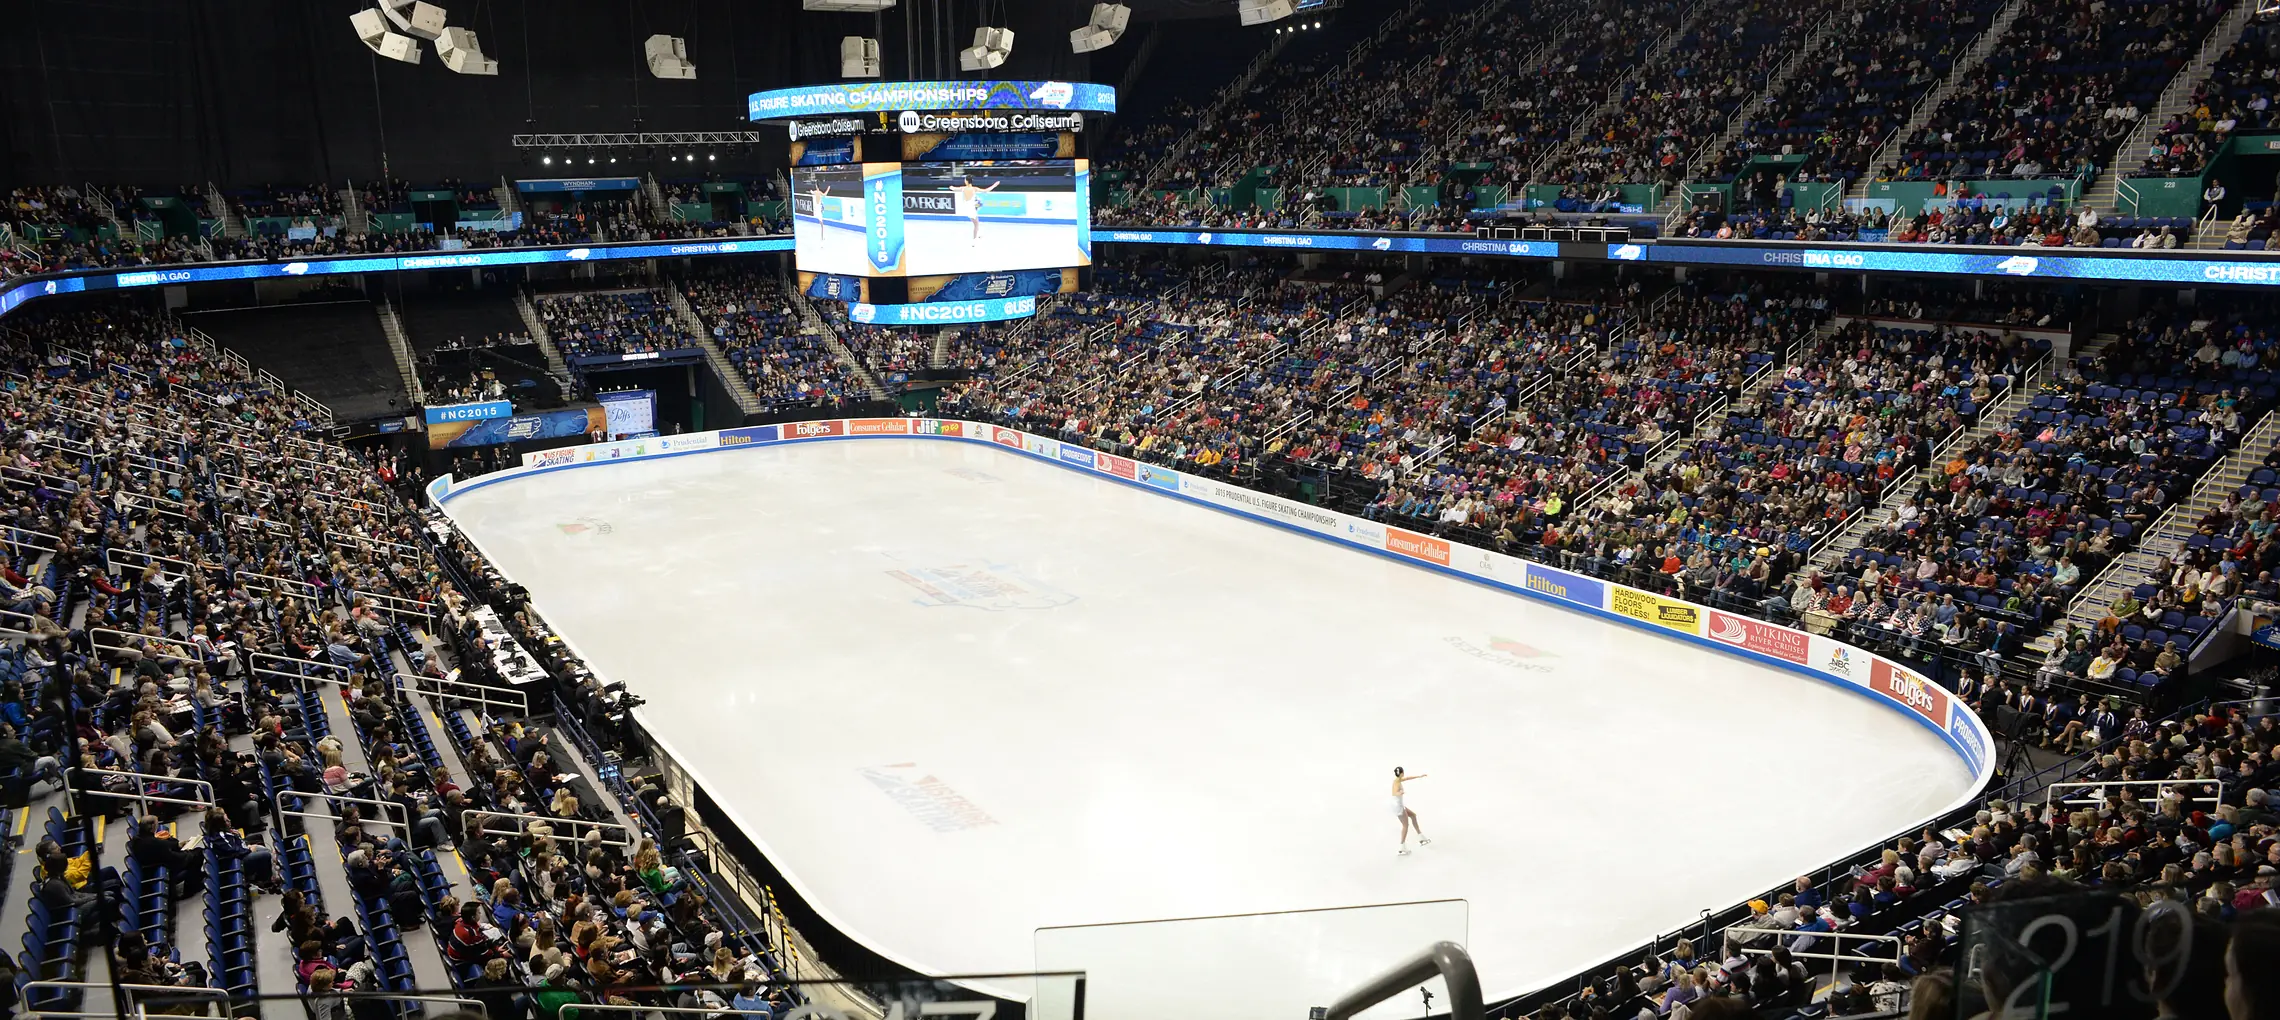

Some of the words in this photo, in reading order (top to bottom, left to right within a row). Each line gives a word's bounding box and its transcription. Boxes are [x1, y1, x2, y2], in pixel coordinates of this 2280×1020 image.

[760, 97, 789, 110] FIGURE
[791, 92, 846, 108] SKATING
[849, 88, 988, 104] CHAMPIONSHIPS
[797, 122, 831, 136] Greensboro
[832, 119, 861, 133] Coliseum
[923, 114, 1008, 129] Greensboro
[1012, 114, 1075, 129] Coliseum
[873, 180, 888, 262] #NC2015
[1113, 232, 1140, 241] CHRISTINA
[1263, 236, 1297, 245] CHRISTINA
[1297, 237, 1312, 245] GAO
[671, 244, 717, 254] CHRISTINA
[719, 243, 737, 251] GAO
[1462, 242, 1507, 252] CHRISTINA
[1509, 244, 1529, 255] GAO
[403, 257, 458, 267] CHRISTINA
[460, 256, 481, 265] GAO
[1764, 252, 1830, 266] CHRISTINA
[1832, 253, 1864, 266] GAO
[119, 273, 168, 285] CHRISTINA
[168, 271, 191, 280] GAO
[900, 303, 986, 320] #NC2015
[441, 406, 497, 420] #NC2015
[796, 423, 831, 437] Folgers
[850, 422, 881, 432] Consumer
[881, 421, 906, 431] Cellular
[917, 419, 939, 434] Jif
[720, 435, 751, 445] Hilton
[555, 448, 576, 458] FIGURE
[1061, 448, 1093, 464] PROGRESSIVE
[546, 455, 574, 466] SKATING
[1113, 458, 1133, 469] VIKING
[1215, 487, 1226, 497] 2015
[1226, 489, 1252, 505] PRUDENTIAL
[1252, 498, 1261, 507] U.S.
[1261, 499, 1277, 511] FIGURE
[1278, 503, 1297, 517] SKATING
[1297, 508, 1336, 527] CHAMPIONSHIPS
[1386, 532, 1420, 553] Consumer
[1420, 540, 1449, 560] Cellular
[1527, 574, 1567, 597] Hilton
[1615, 588, 1656, 605] HARDWOOD
[1615, 596, 1642, 609] FLOORS
[1615, 604, 1628, 613] FOR
[1630, 609, 1650, 619] LESS!
[1661, 613, 1694, 622] LIQUIDATORS
[1666, 607, 1688, 615] LUMBER
[1755, 624, 1801, 645] VIKING
[1747, 642, 1766, 652] Exploring
[1772, 648, 1784, 656] World
[1750, 635, 1772, 646] RIVER
[1774, 641, 1804, 655] CRUISES
[1828, 662, 1851, 676] Sports
[1831, 658, 1850, 671] NBC
[1889, 667, 1933, 712] Folgers
[1953, 715, 1985, 771] PROGRES
[2001, 899, 2194, 1017] 219
